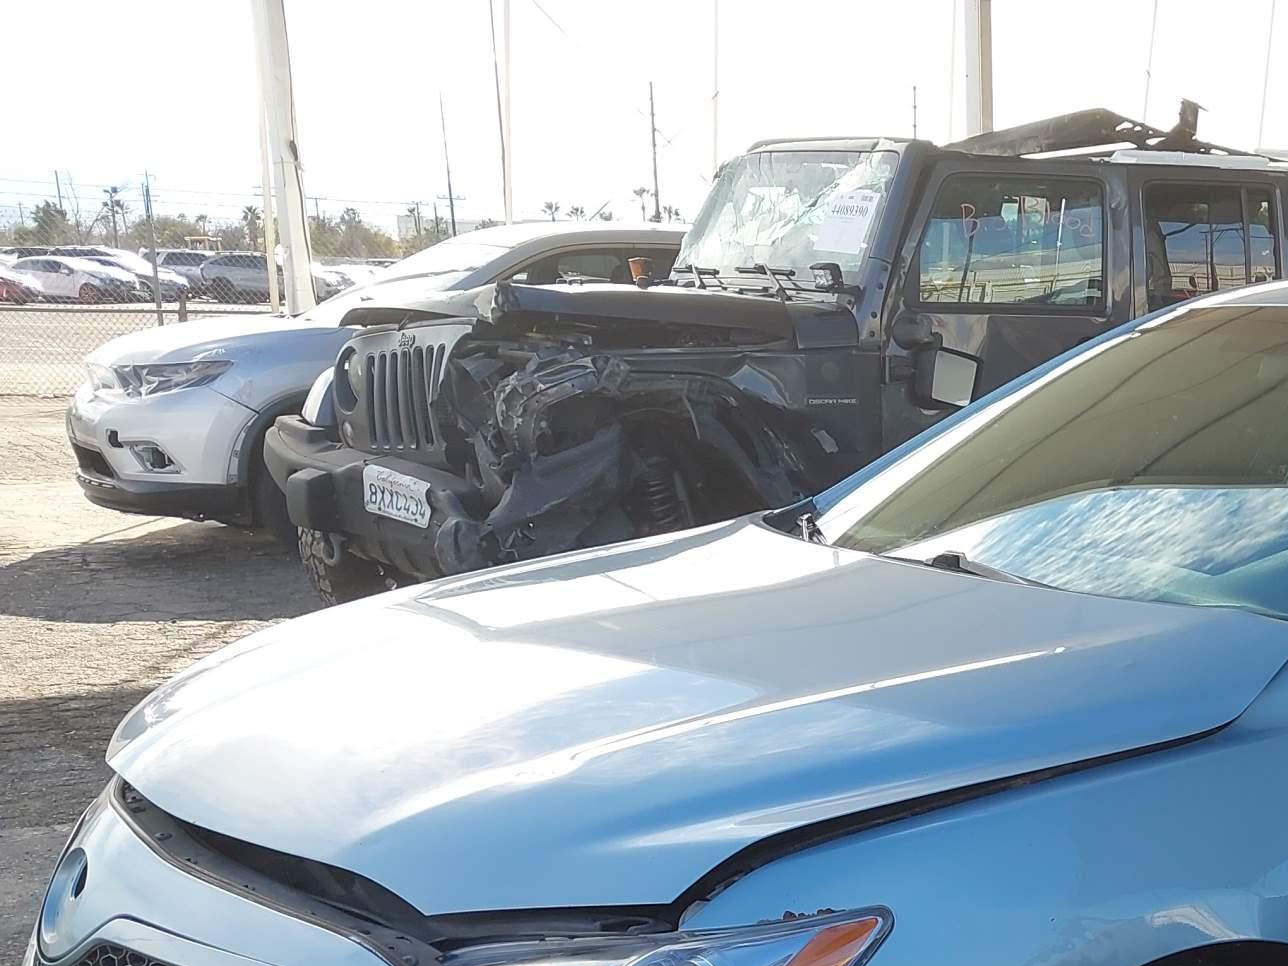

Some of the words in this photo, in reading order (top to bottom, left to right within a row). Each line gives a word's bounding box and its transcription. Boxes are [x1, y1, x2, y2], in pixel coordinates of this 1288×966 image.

[831, 203, 869, 217] 44089390
[1020, 196, 1096, 240] Blood
[376, 470, 414, 491] California
